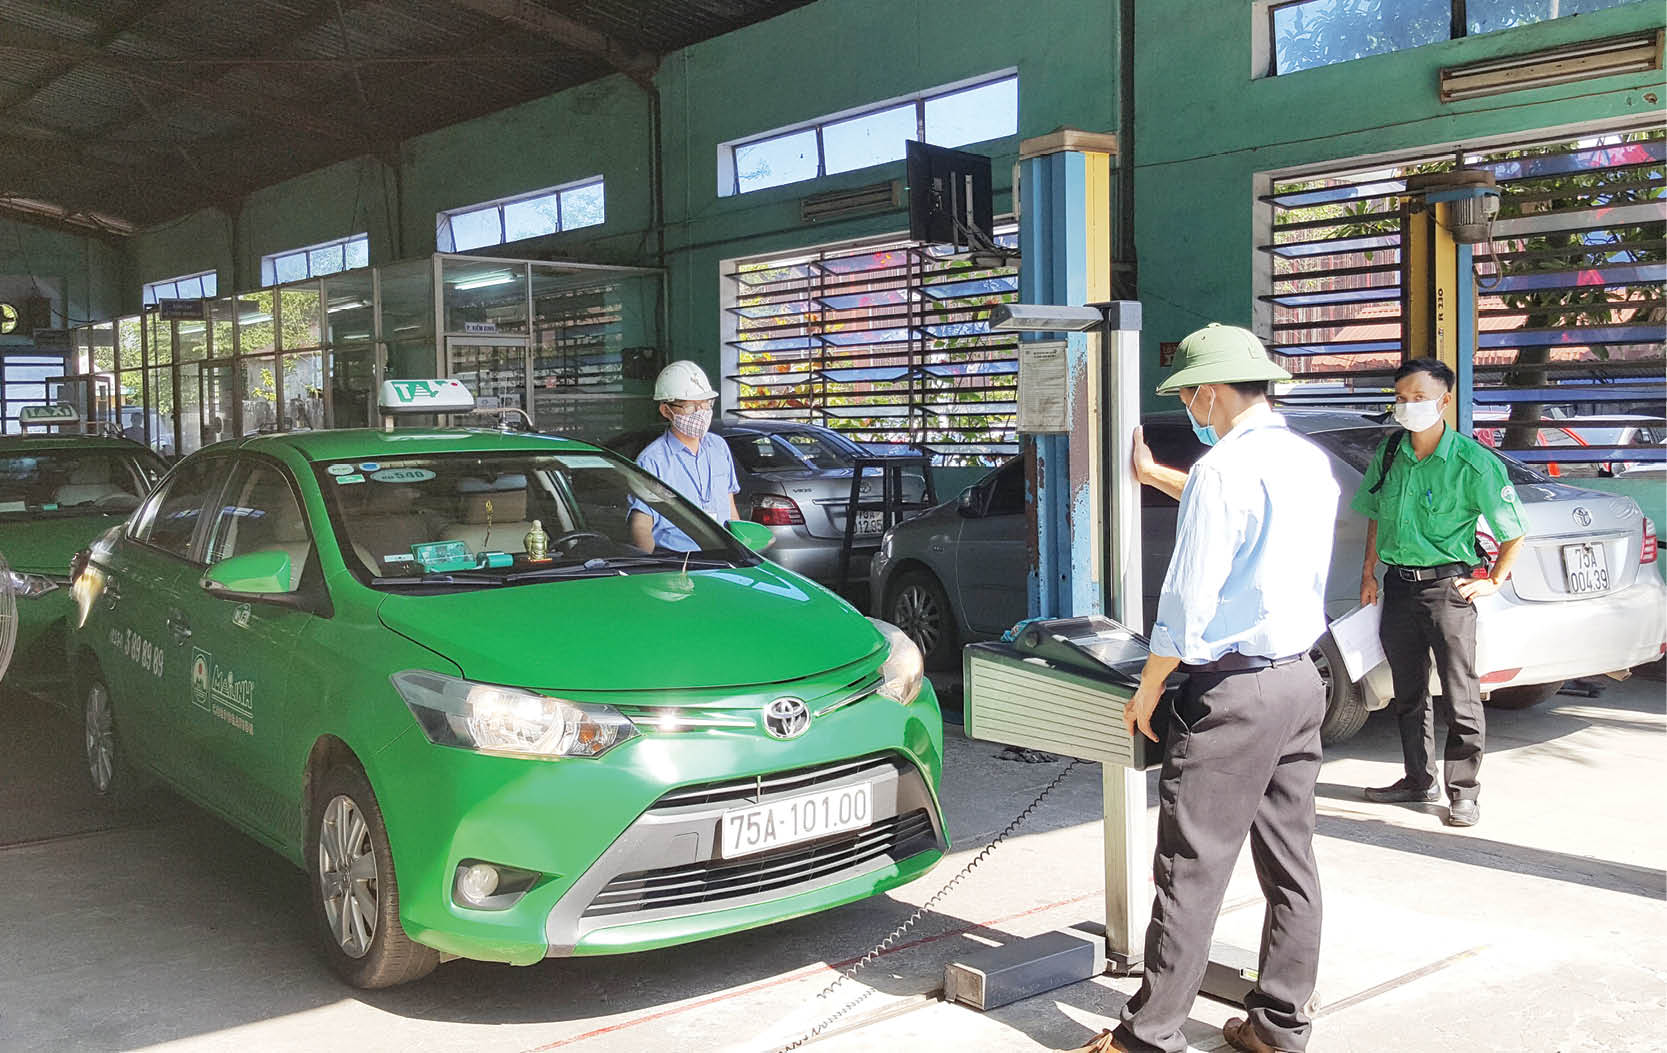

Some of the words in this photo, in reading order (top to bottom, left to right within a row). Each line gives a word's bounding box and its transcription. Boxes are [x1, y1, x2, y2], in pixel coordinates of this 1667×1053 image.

[392, 381, 448, 402] TA
[26, 407, 72, 418] TAXI
[1574, 548, 1598, 569] 75A
[730, 789, 866, 849] 75A-101.00
